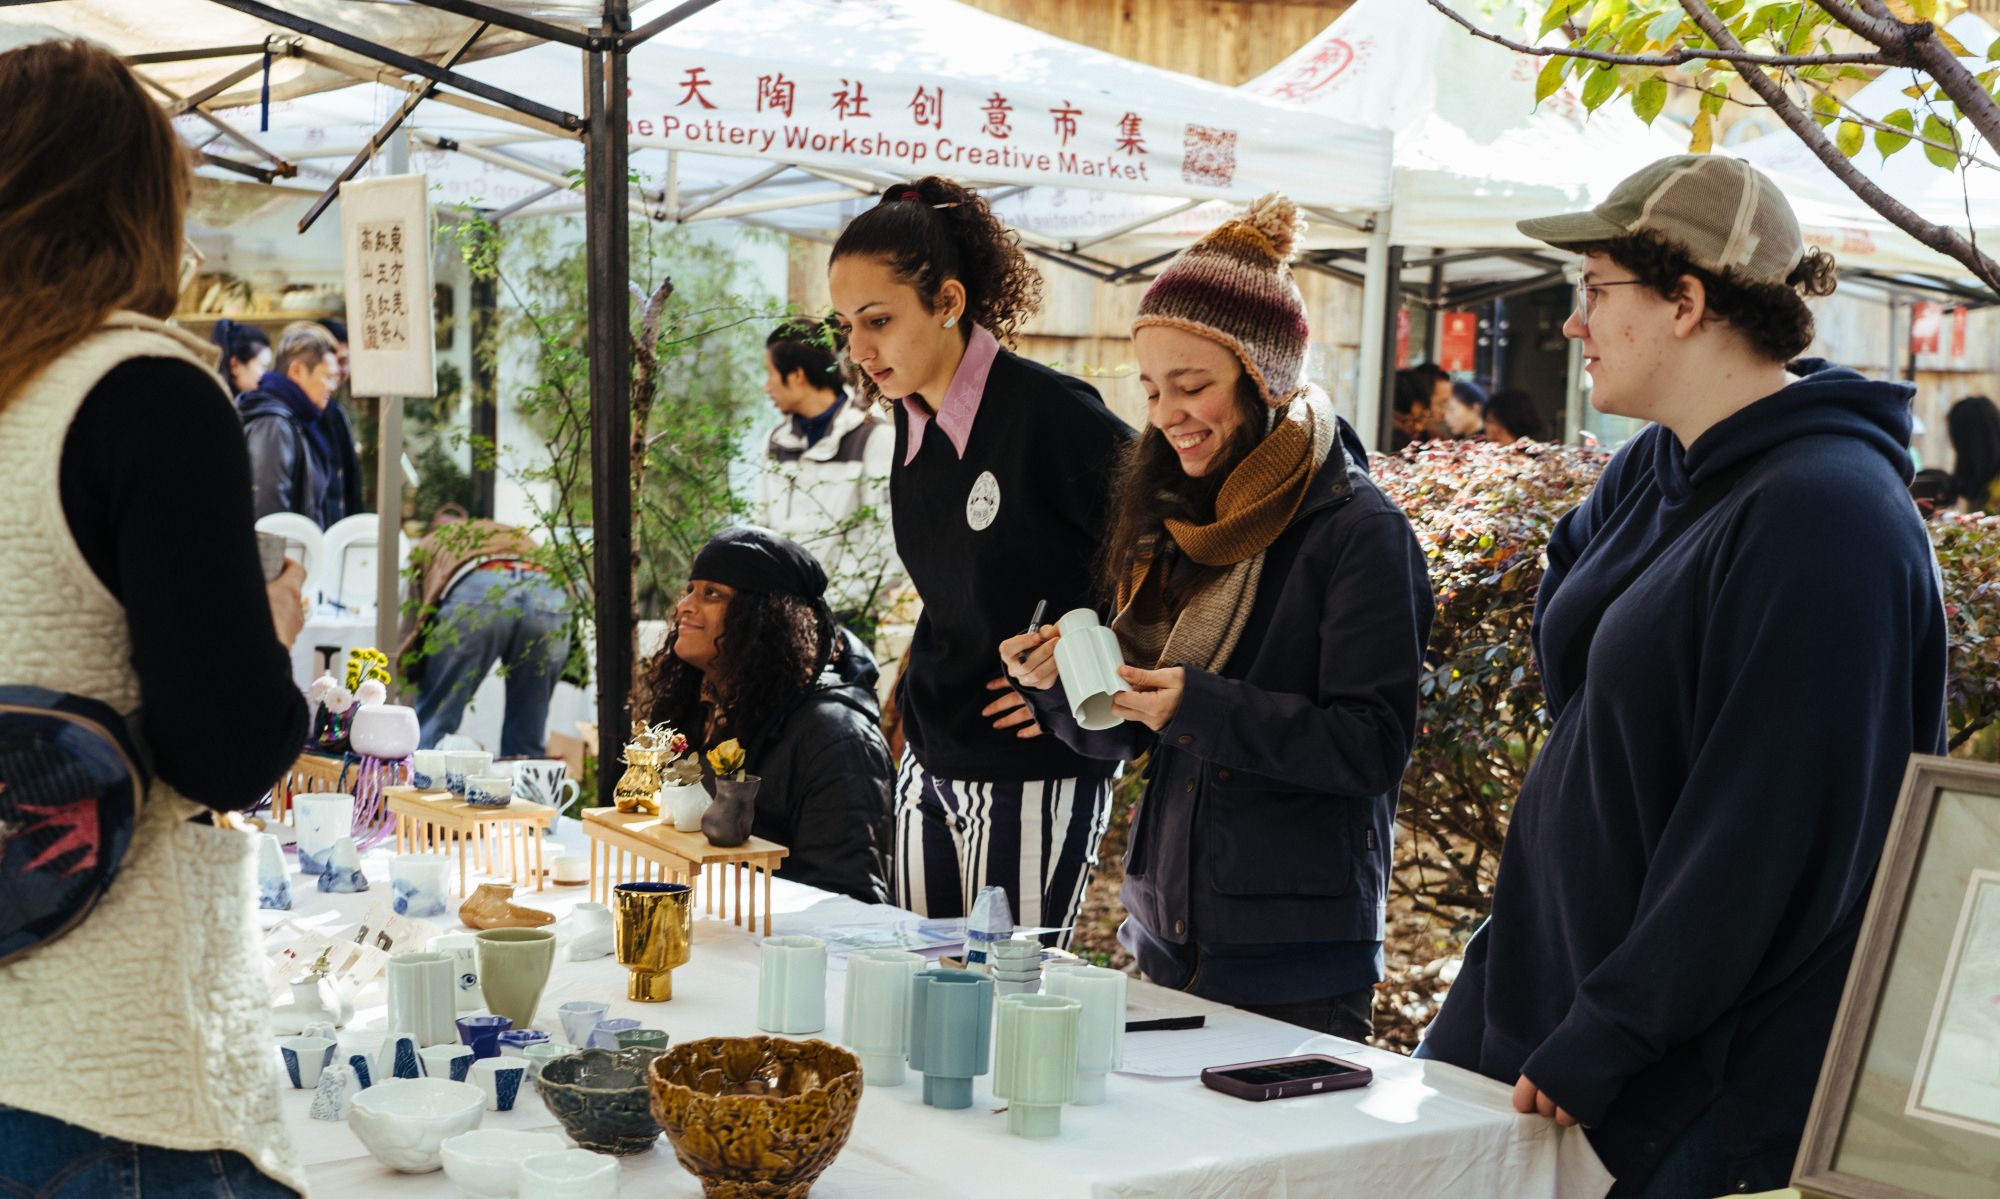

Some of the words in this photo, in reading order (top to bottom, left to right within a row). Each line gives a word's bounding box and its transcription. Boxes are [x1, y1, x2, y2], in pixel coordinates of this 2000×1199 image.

[627, 66, 1149, 157] 天陶社创意市集
[663, 115, 776, 152] Pottery
[784, 125, 927, 165] Workshop
[935, 138, 1051, 171] Creative
[1058, 152, 1149, 181] Market
